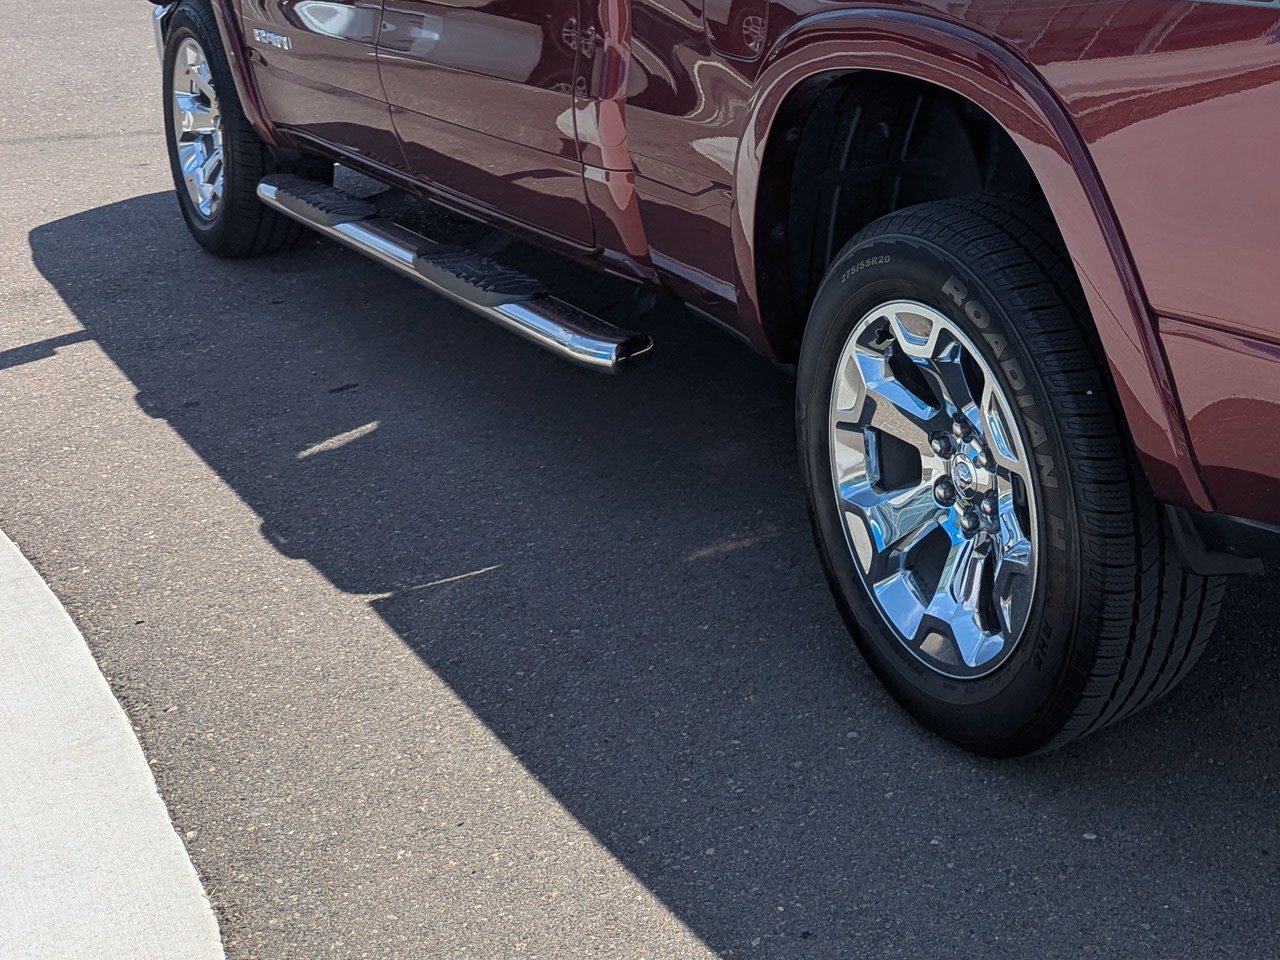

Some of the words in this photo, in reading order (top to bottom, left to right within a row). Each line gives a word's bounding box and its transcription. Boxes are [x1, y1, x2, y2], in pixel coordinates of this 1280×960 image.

[252, 28, 292, 50] RAM
[840, 255, 891, 284] 275/55R20
[940, 273, 1059, 489] ROADIAN
